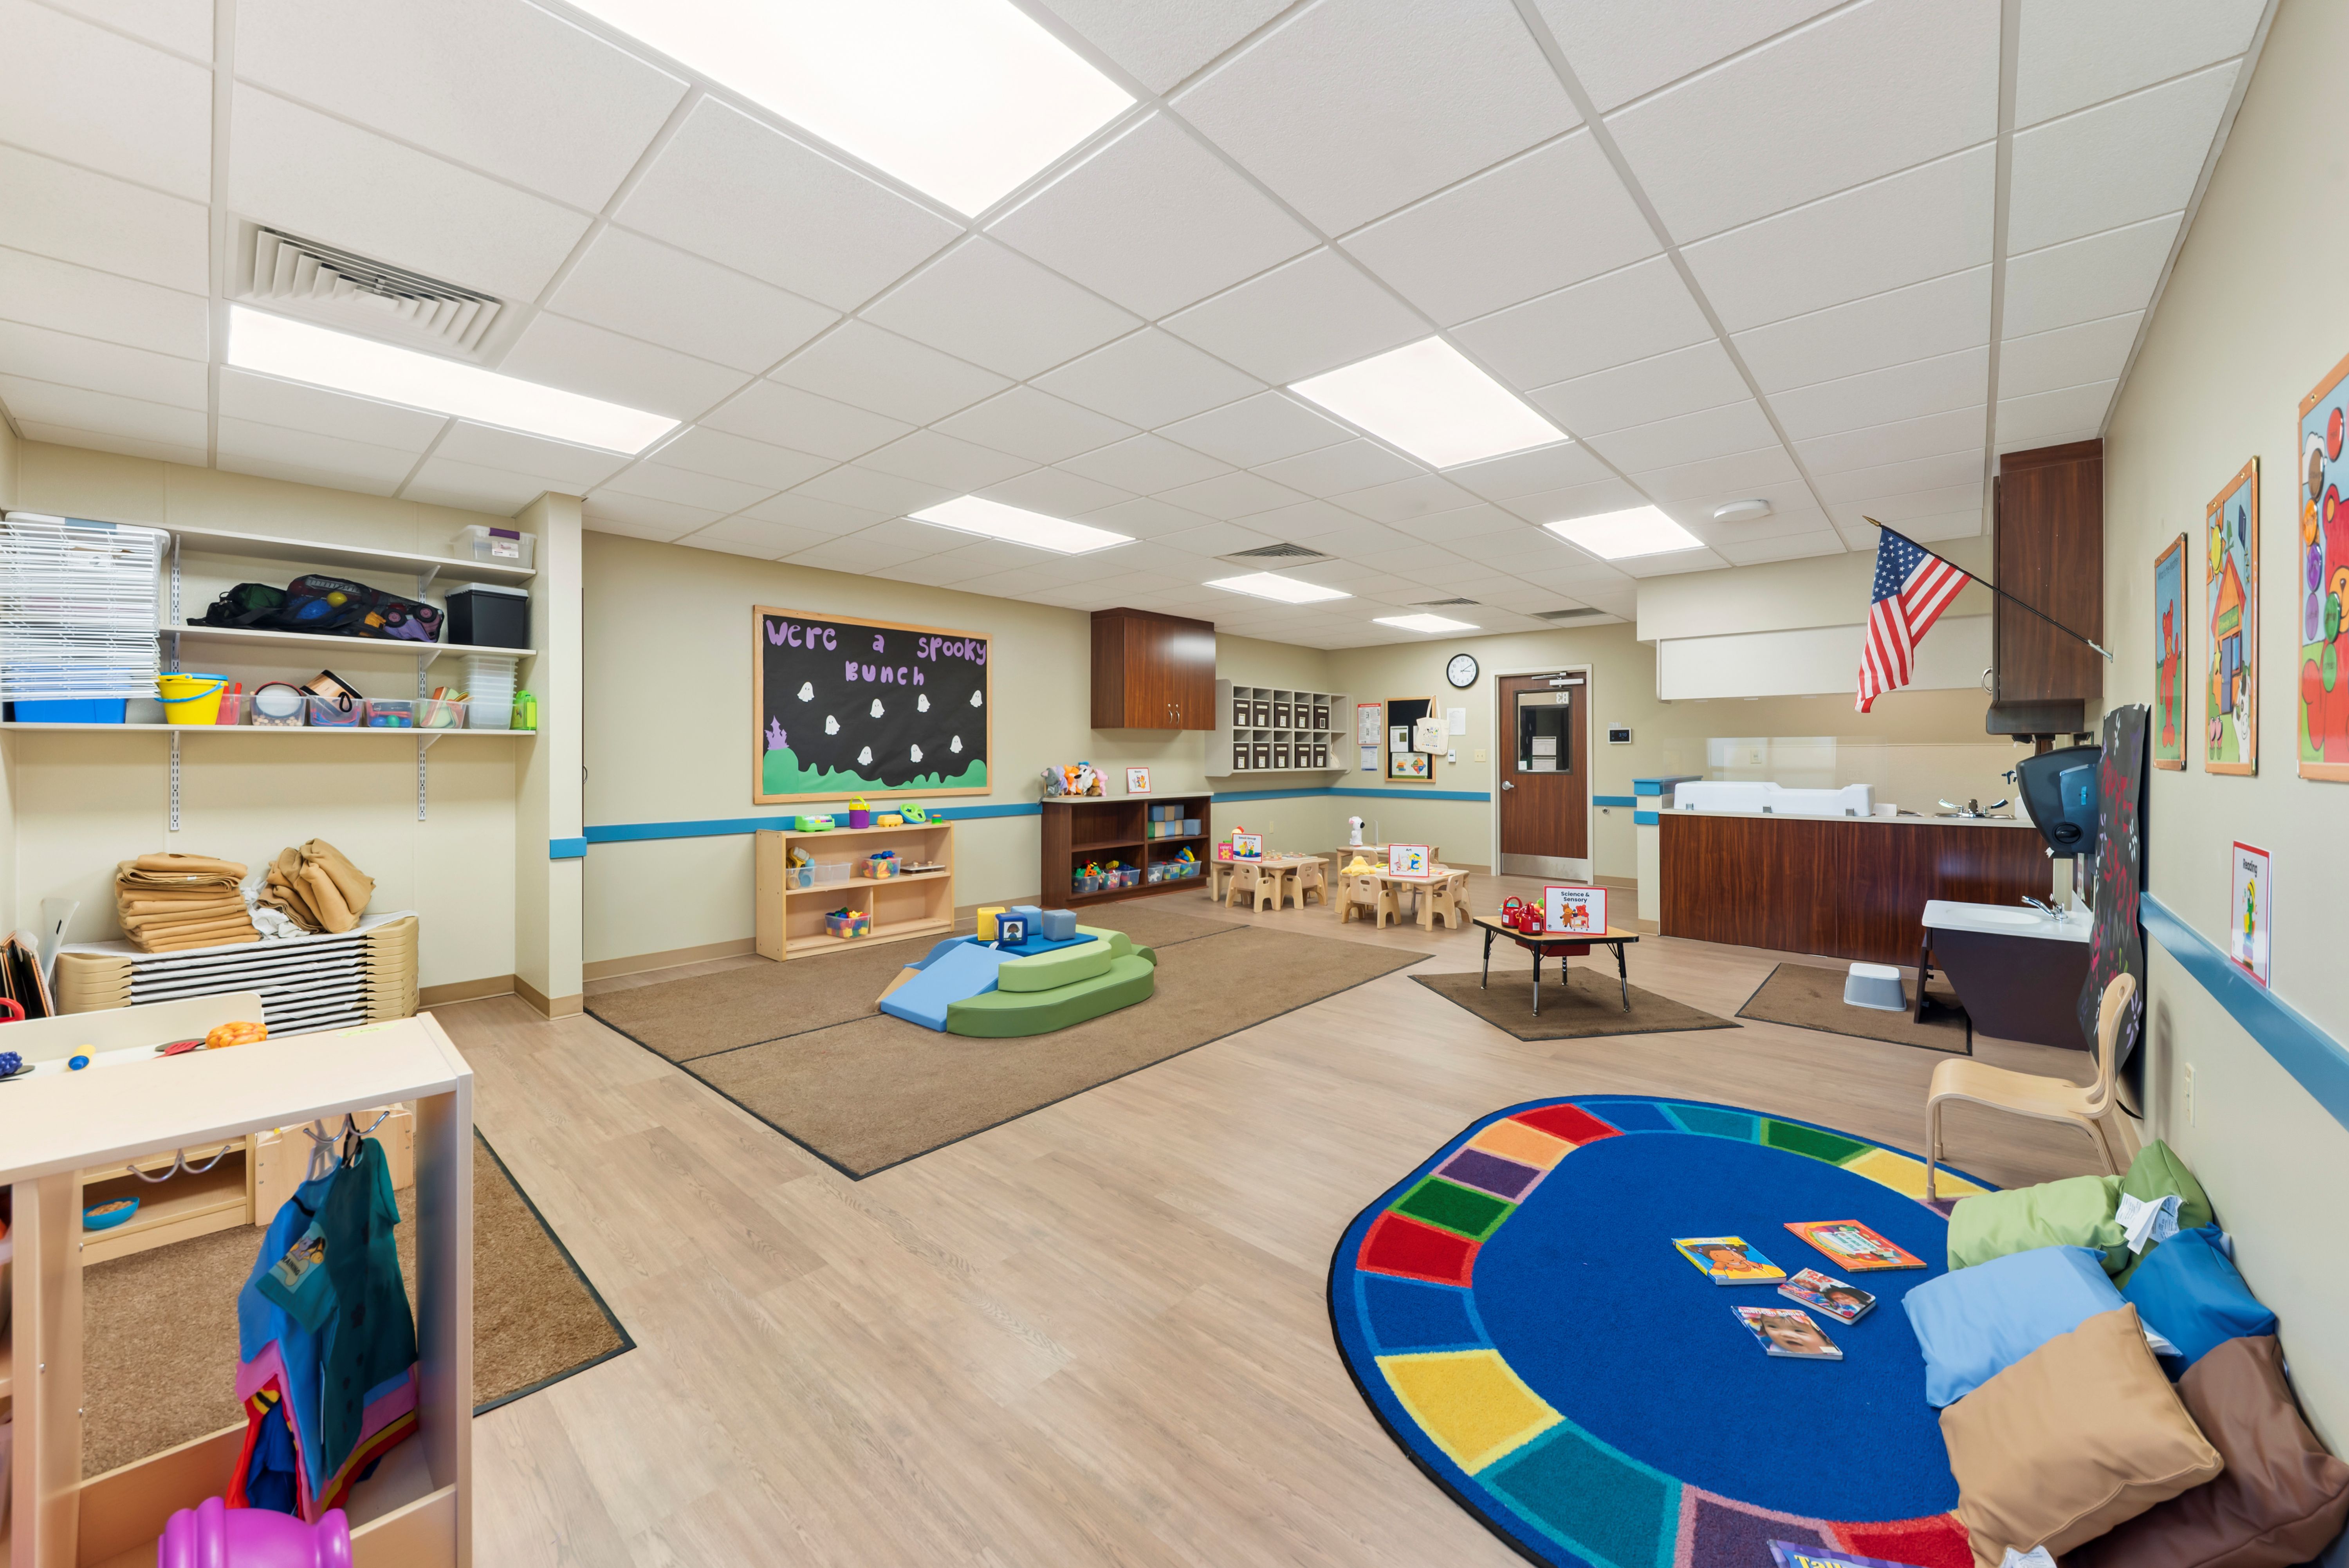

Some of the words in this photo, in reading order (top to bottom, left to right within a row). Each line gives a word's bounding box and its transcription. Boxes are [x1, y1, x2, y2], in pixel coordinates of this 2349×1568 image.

[766, 620, 837, 651] Were
[873, 635, 884, 653] a
[2243, 858, 2257, 877] Reading
[280, 1255, 300, 1276] RAINING
